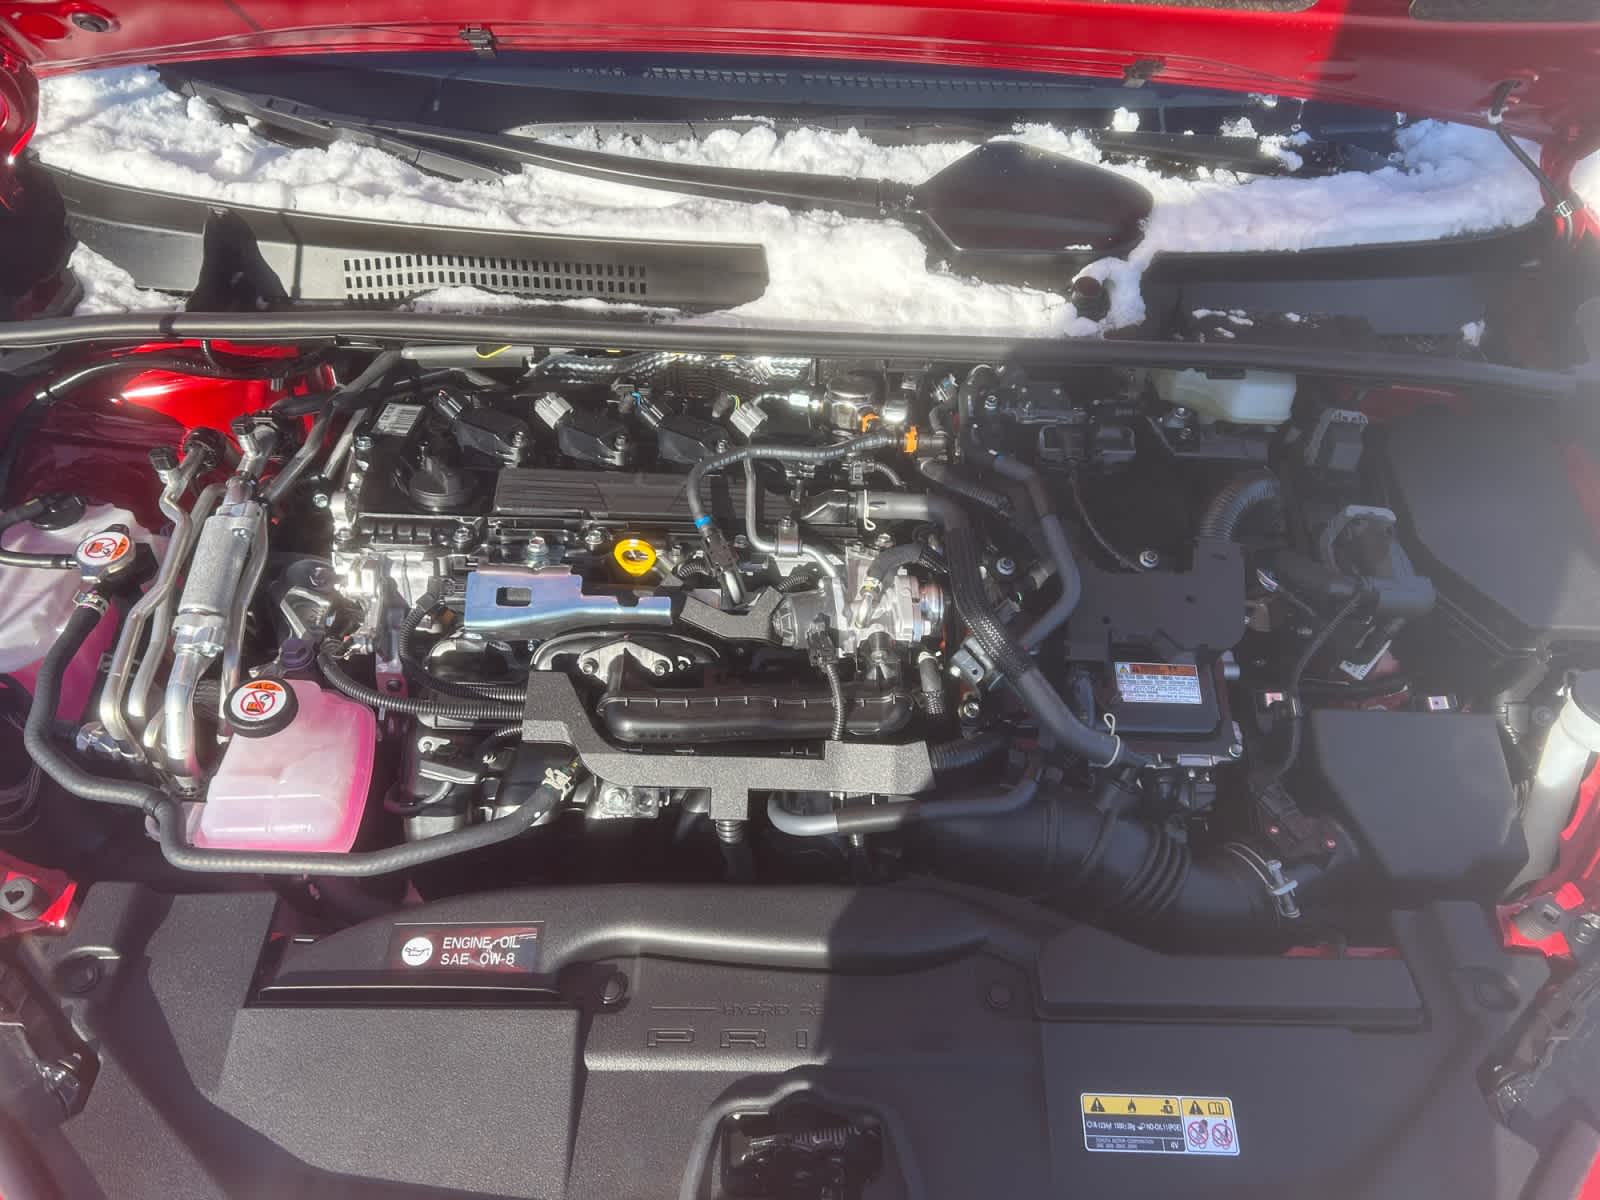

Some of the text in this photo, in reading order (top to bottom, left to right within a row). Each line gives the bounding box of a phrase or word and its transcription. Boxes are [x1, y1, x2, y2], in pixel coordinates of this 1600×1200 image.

[442, 935, 521, 949] ENGINE OIL
[440, 952, 516, 966] SAE 0W-8
[722, 1003, 791, 1017] HYBRID
